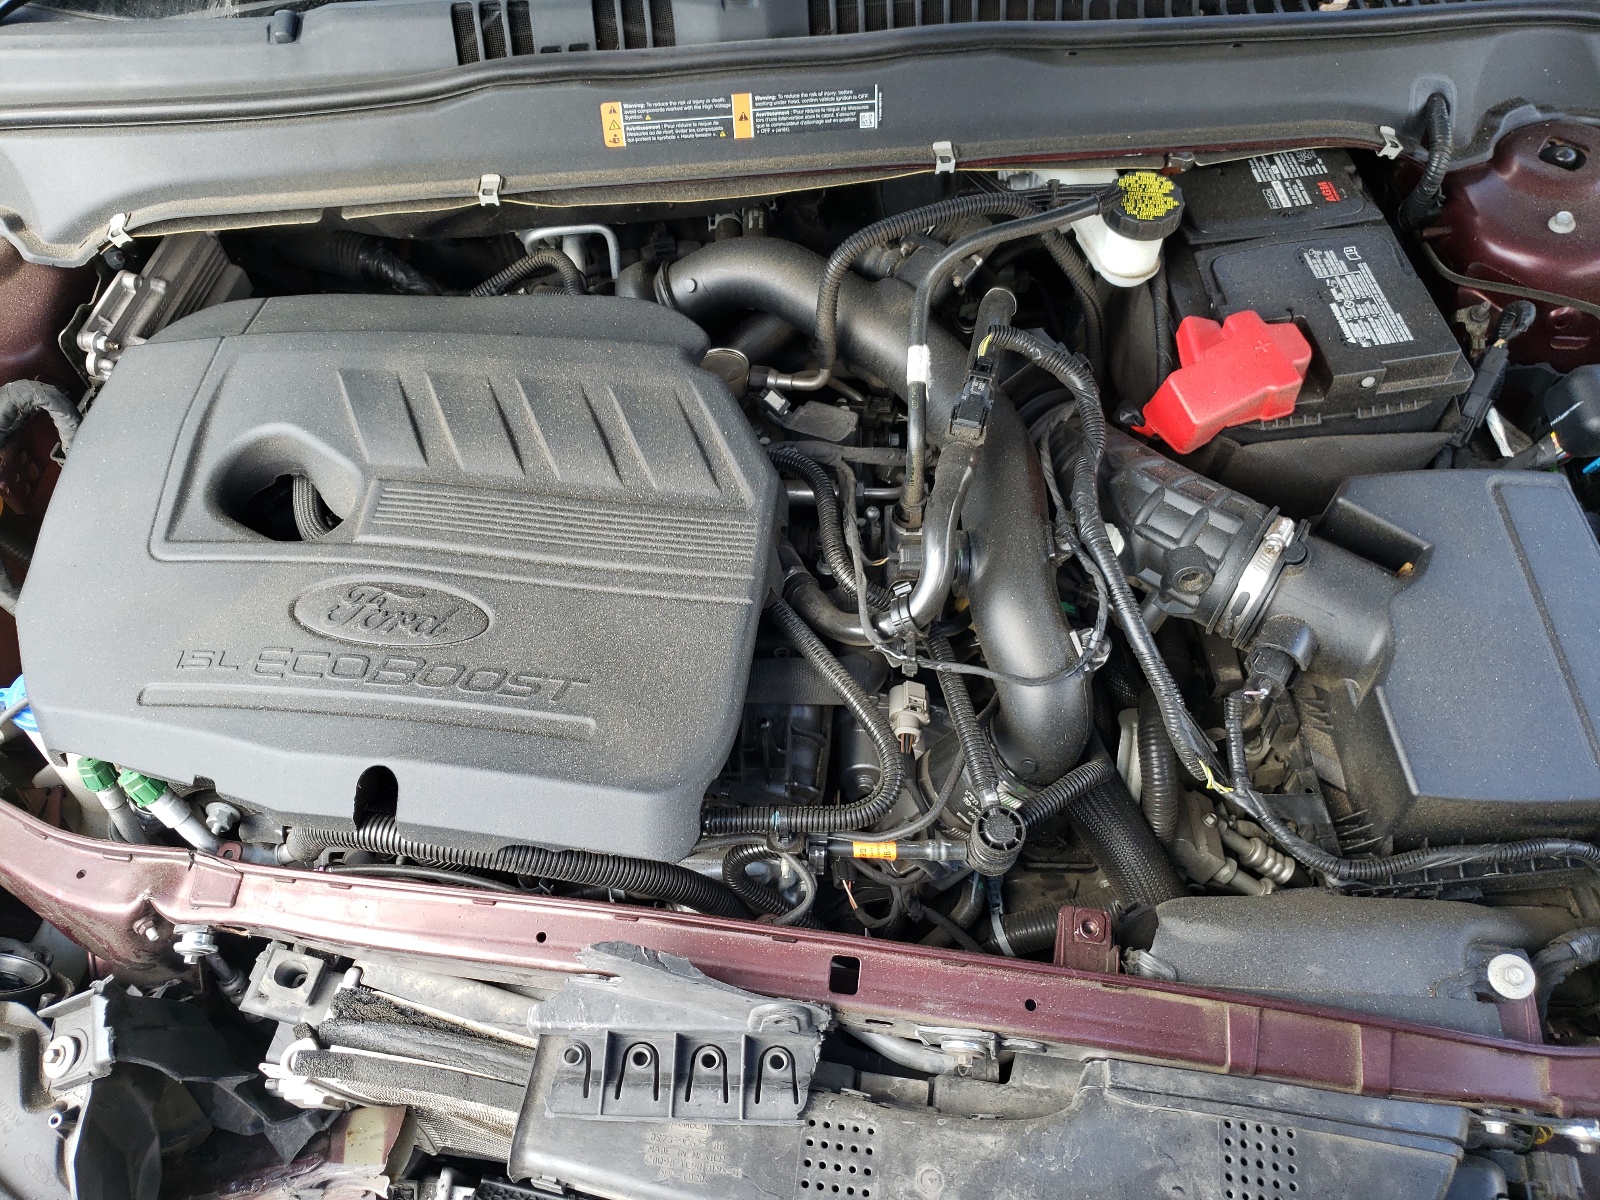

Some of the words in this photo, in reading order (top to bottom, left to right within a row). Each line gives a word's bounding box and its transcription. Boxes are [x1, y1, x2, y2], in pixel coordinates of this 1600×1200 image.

[1317, 181, 1338, 202] AGM
[328, 584, 461, 640] Ford
[647, 1145, 671, 1154] MADE
[692, 1151, 726, 1163] MEXICO
